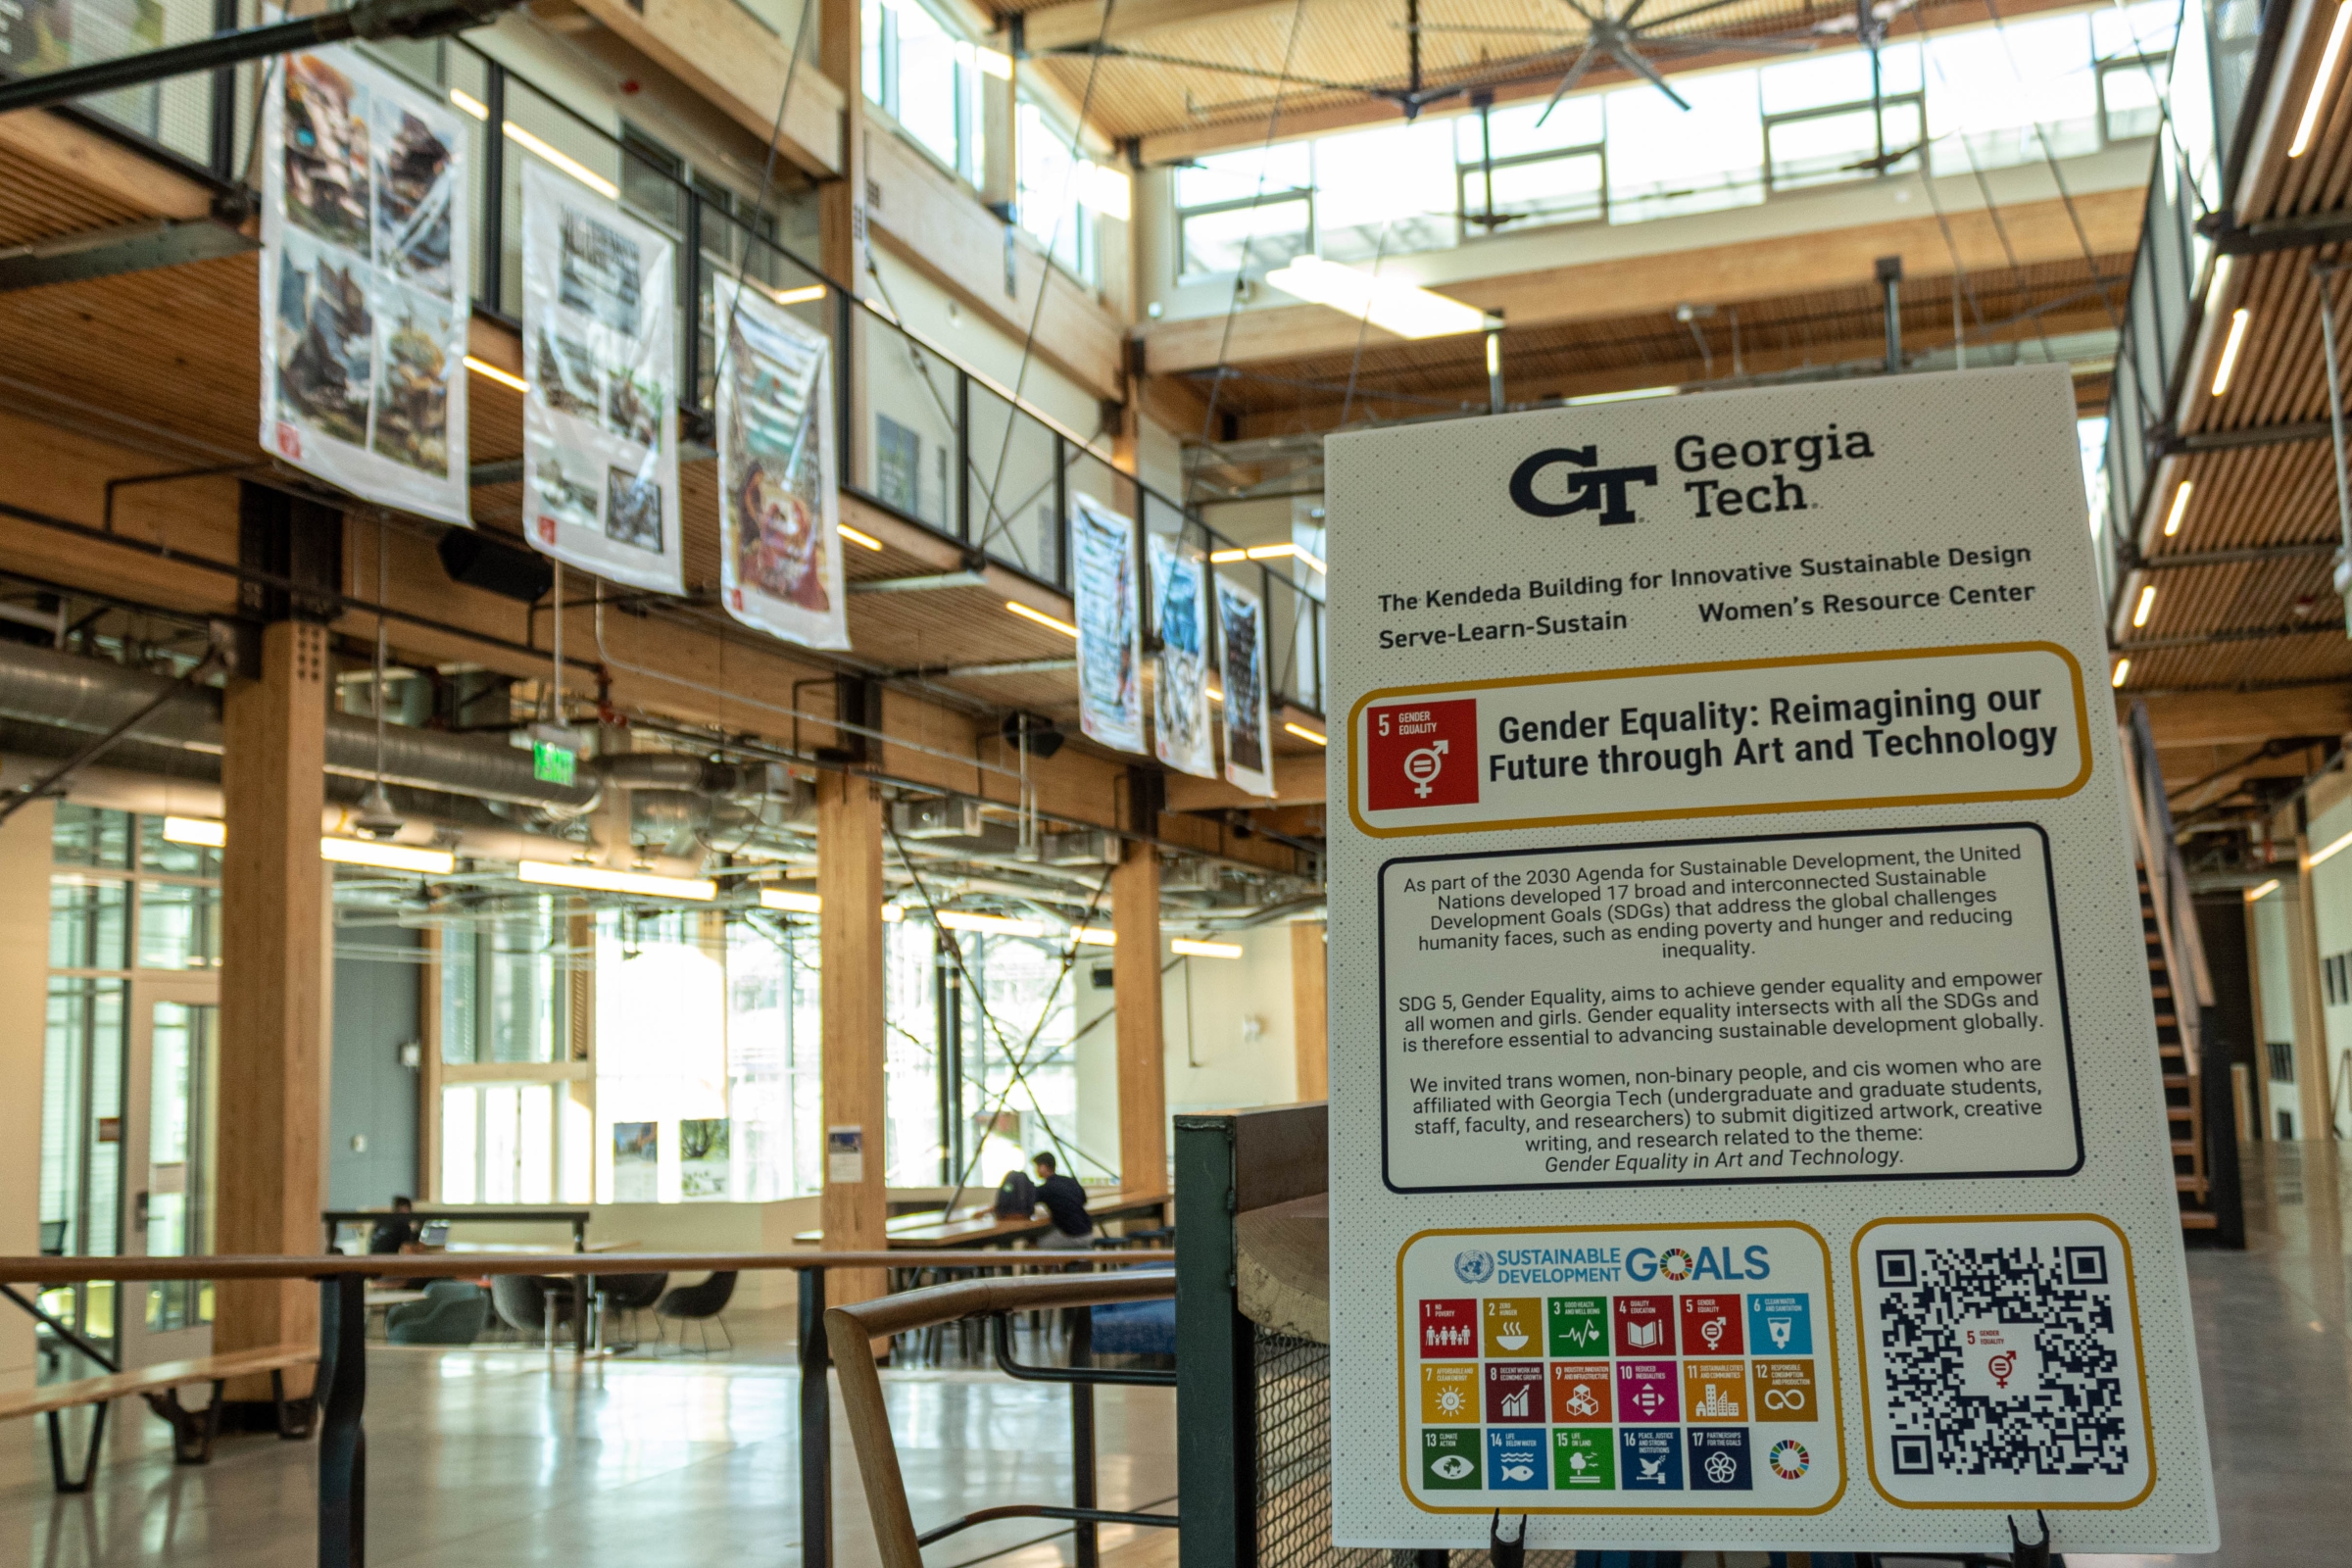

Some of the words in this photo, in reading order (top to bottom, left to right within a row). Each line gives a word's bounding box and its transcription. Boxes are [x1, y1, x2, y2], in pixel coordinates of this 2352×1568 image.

[1674, 422, 1876, 473] Georgia
[1508, 445, 1658, 526] GT
[1683, 471, 1809, 518] Tech
[1377, 593, 1418, 612] The
[1426, 582, 1522, 609] Kendeda
[1529, 575, 1624, 600] Building
[1628, 571, 1663, 591] for
[1671, 564, 1792, 587] Innovative
[1799, 550, 1941, 577] Sustainable
[1947, 544, 2032, 568] Design
[1697, 596, 1815, 623] Women's
[1822, 591, 1941, 614] Resource
[1948, 584, 2036, 606] Center
[1379, 613, 1628, 650] Serve-Learn-Sustain
[1379, 713, 1390, 737] 5
[1398, 710, 1430, 723] GENDER
[1398, 722, 1437, 736] EQUALITY
[1498, 710, 1610, 745] Gender
[1620, 700, 1759, 742] Equality:
[1769, 686, 1977, 727] Reimagining
[1986, 688, 2042, 713] our
[1489, 754, 1589, 783] Future
[1597, 738, 1723, 777] through
[1733, 737, 1786, 766] Art
[1794, 729, 1854, 762] and
[1861, 720, 2058, 759] Technology
[1403, 877, 1426, 893] As
[1431, 875, 1466, 895] part
[1470, 871, 1490, 889] of
[1493, 871, 1522, 888] the
[1526, 867, 1571, 886] 2030
[1576, 863, 1644, 886] Agenda
[1648, 861, 1675, 878] for
[1680, 856, 1788, 876] Sustainable
[1792, 851, 1920, 871] Development,
[1924, 848, 1955, 864] the
[1959, 843, 2022, 862] United
[1438, 893, 1505, 910] Nations
[1510, 885, 1601, 906] developed
[1606, 884, 1629, 901] 17
[1635, 880, 1687, 900] broad
[1691, 878, 1726, 896] and
[1731, 871, 1870, 894] interconnected
[1875, 865, 1986, 887] Sustainable
[1431, 909, 1546, 931] Development
[1550, 906, 1602, 924] Goals
[1607, 901, 1671, 924] (SDGs)
[1675, 900, 1712, 917] that
[1717, 897, 1791, 915] address
[1795, 894, 1827, 911] the
[1832, 890, 1888, 913] global
[1893, 888, 1997, 907] challenges
[1418, 932, 1499, 952] humanity
[1504, 929, 1557, 947] faces,
[1562, 925, 1605, 944] such
[1611, 927, 1633, 941] as
[1637, 921, 1698, 941] ending
[1704, 918, 1773, 940] poverty
[1778, 914, 1813, 933] and
[1818, 914, 1884, 933] hunger
[1888, 909, 1924, 928] and
[1930, 907, 2013, 927] reducing
[1662, 939, 1755, 961] inequality.
[1398, 995, 1436, 1012] SDG
[1442, 994, 1456, 1012] 5,
[1461, 991, 1526, 1009] Gender
[1530, 987, 1606, 1009] Equality,
[1610, 985, 1655, 1003] aims
[1659, 985, 1679, 1000] to
[1685, 981, 1755, 999] achieve
[1760, 976, 1826, 1000] gender
[1831, 973, 1906, 996] equality
[1911, 971, 1946, 990] and
[1952, 972, 2043, 991] empower
[1404, 1015, 1425, 1033] all
[1429, 1015, 1494, 1031] women
[1499, 1009, 1533, 1028] and
[1539, 1008, 1582, 1030] girls.
[1588, 1005, 1653, 1024] Gender
[1658, 1002, 1732, 1024] equality
[1736, 999, 1830, 1017] intersects
[1834, 996, 1875, 1013] with
[1881, 994, 1902, 1012] all
[1906, 994, 1938, 1011] the
[1943, 992, 1997, 1009] SDGs
[2003, 989, 2039, 1007] and
[1402, 1037, 1417, 1053] is
[1421, 1033, 1503, 1053] therefore
[1508, 1028, 1590, 1049] essential
[1593, 1029, 1613, 1045] to
[1618, 1024, 1713, 1044] advancing
[1718, 1018, 1828, 1040] sustainable
[1833, 1015, 1958, 1037] development
[1963, 1010, 2044, 1035] globally.
[1409, 1077, 1438, 1094] We
[1444, 1073, 1501, 1093] invited
[1506, 1074, 1553, 1090] trans
[1557, 1072, 1631, 1088] women,
[1635, 1066, 1733, 1086] non-binary
[1739, 1062, 1807, 1085] people,
[1812, 1059, 1847, 1079] and
[1853, 1060, 1881, 1077] cis
[1886, 1060, 1958, 1076] women
[1963, 1055, 2005, 1073] who
[2010, 1057, 2041, 1072] are
[1413, 1095, 1492, 1114] affiliated
[1496, 1093, 1535, 1111] with
[1540, 1091, 1611, 1112] Georgia
[1615, 1088, 1662, 1106] Tech
[1667, 1084, 1813, 1109] (undergraduate
[1818, 1082, 1853, 1100] and
[1859, 1080, 1945, 1102] graduate
[1951, 1077, 2042, 1096] students,
[1414, 1116, 1460, 1136] staff,
[1464, 1115, 1530, 1136] faculty,
[1536, 1112, 1569, 1131] and
[1574, 1107, 1691, 1130] researchers)
[1695, 1109, 1716, 1125] to
[1721, 1105, 1788, 1125] submit
[1791, 1102, 1874, 1126] digitized
[1880, 1101, 1959, 1120] artwork,
[1964, 1099, 2042, 1117] creative
[1525, 1135, 1592, 1154] writing,
[1597, 1132, 1632, 1151] and
[1637, 1129, 1718, 1149] research
[1724, 1127, 1789, 1146] related
[1793, 1128, 1815, 1145] to
[1818, 1125, 1851, 1144] the
[1854, 1125, 1923, 1143] theme:
[1544, 1154, 1611, 1173] Gender
[1615, 1152, 1689, 1175] Equality
[1693, 1152, 1709, 1168] in
[1714, 1151, 1743, 1168] Art
[1748, 1149, 1784, 1167] and
[1788, 1147, 1903, 1168] Technology.
[1497, 1248, 1622, 1266] SUSTAINABLE
[1497, 1267, 1622, 1285] DEVELOPMENT
[1425, 1303, 1432, 1318] 1
[1686, 1298, 1693, 1313] 5
[1966, 1330, 1976, 1346] 5
[1425, 1433, 1437, 1447] 13
